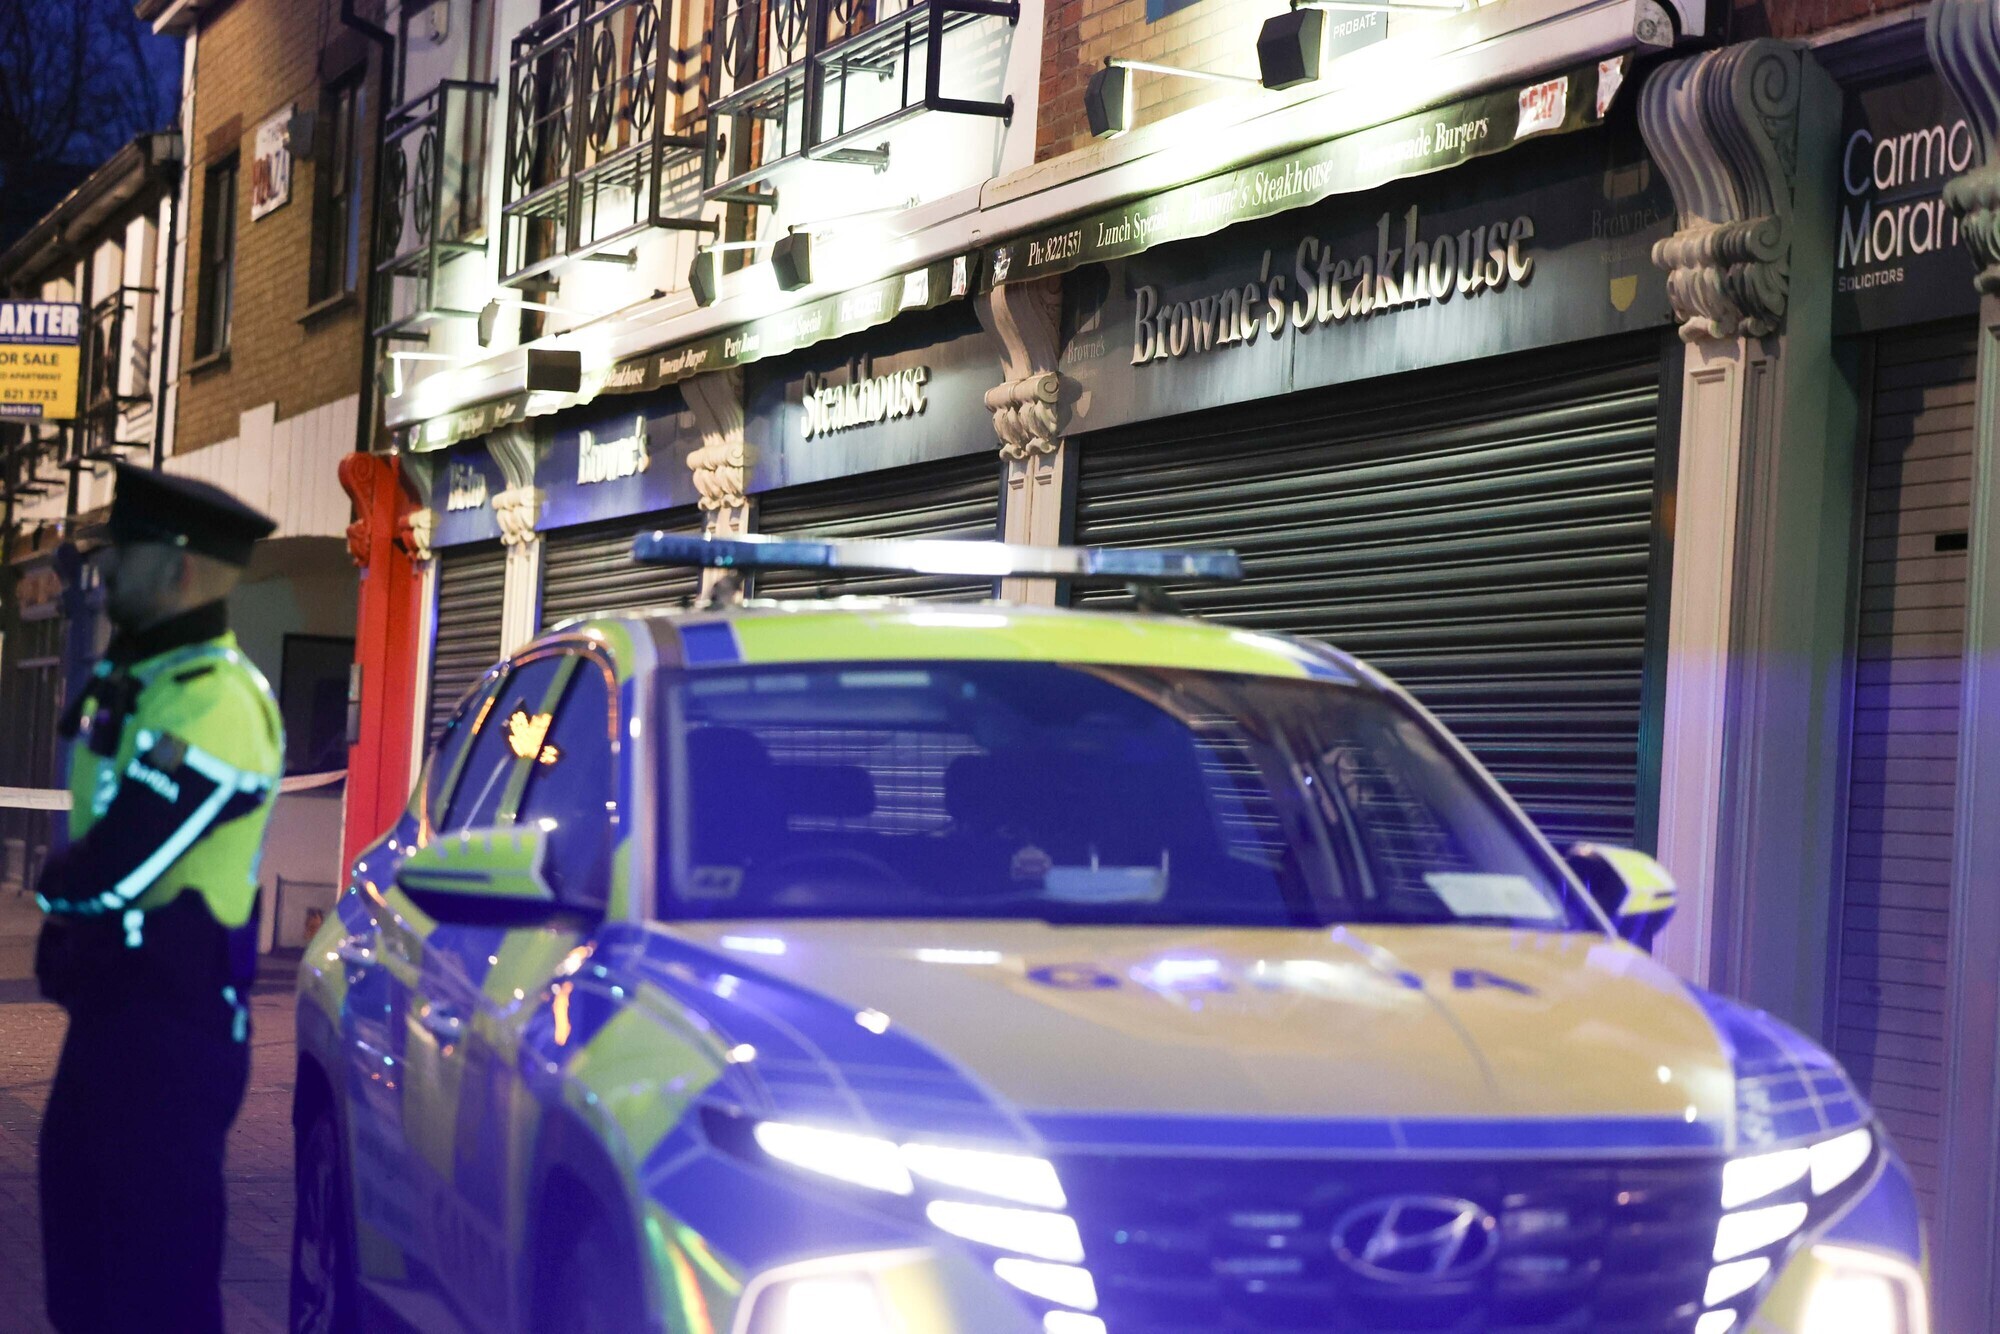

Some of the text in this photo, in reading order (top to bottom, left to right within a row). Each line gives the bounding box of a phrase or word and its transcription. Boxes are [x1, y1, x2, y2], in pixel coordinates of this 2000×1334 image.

[1333, 11, 1377, 40] PROBATE
[1434, 117, 1489, 154] Burgers
[1251, 159, 1334, 206] Steakhouse
[1027, 242, 1045, 267] Ph:
[1096, 222, 1131, 248] Lunch
[1129, 203, 1536, 367] Browne's Steakhouse
[1838, 268, 1905, 292] SOLICITORS
[23, 353, 58, 365] SALE
[1067, 335, 1105, 364] Browne's
[801, 351, 929, 439] Steakhouse
[576, 415, 650, 485] Browne's
